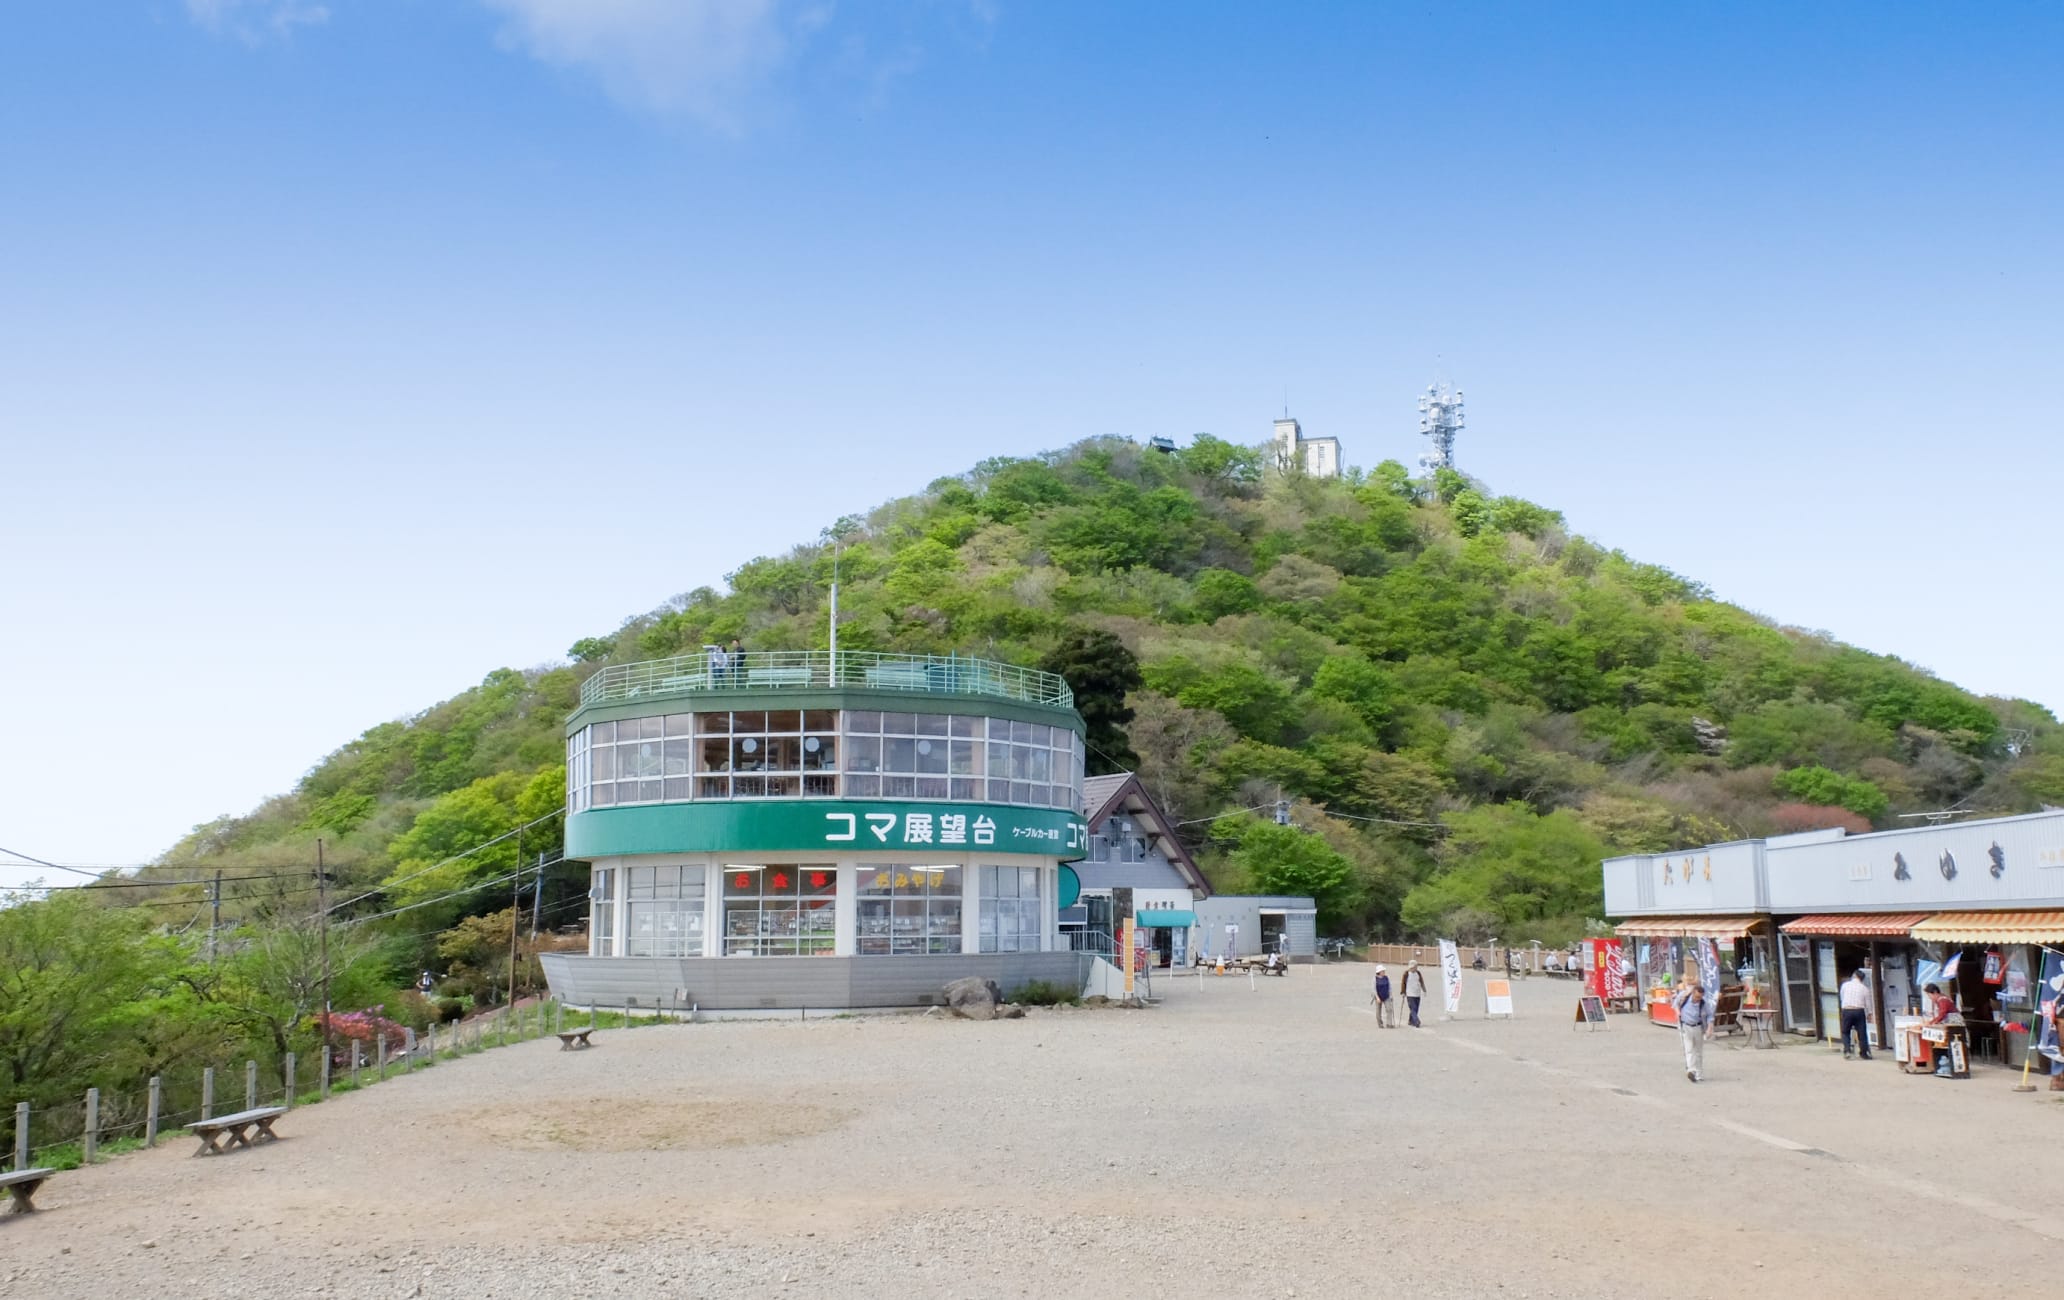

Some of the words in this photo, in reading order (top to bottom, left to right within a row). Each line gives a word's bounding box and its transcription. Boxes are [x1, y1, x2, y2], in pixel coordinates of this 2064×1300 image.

[825, 812, 996, 844] コマ展望台
[1066, 822, 1089, 852] コマ
[734, 872, 828, 889] お食事
[875, 872, 945, 888] おみやげ
